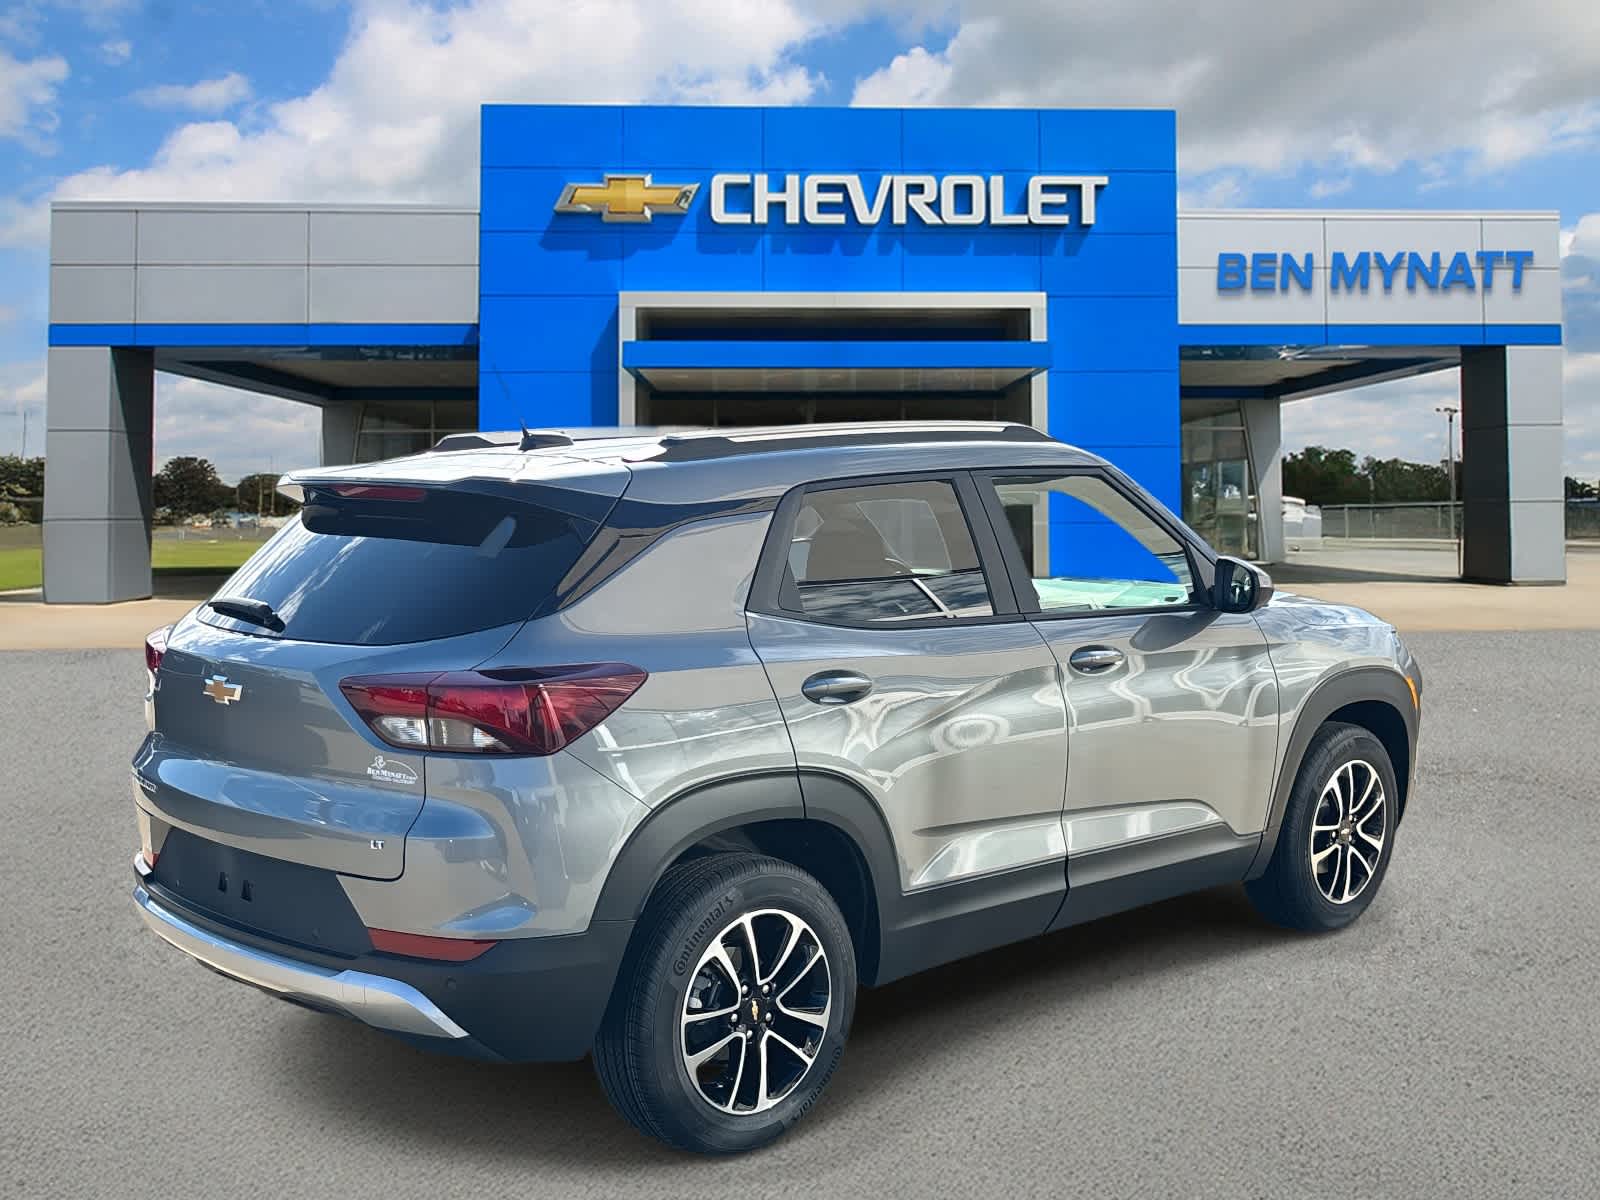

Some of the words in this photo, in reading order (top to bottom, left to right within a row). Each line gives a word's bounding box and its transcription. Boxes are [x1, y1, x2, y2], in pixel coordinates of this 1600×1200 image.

[711, 173, 1108, 225] CHEVROLET
[1217, 252, 1313, 290] BEN
[1330, 250, 1534, 290] MYNATT
[370, 839, 384, 850] LT
